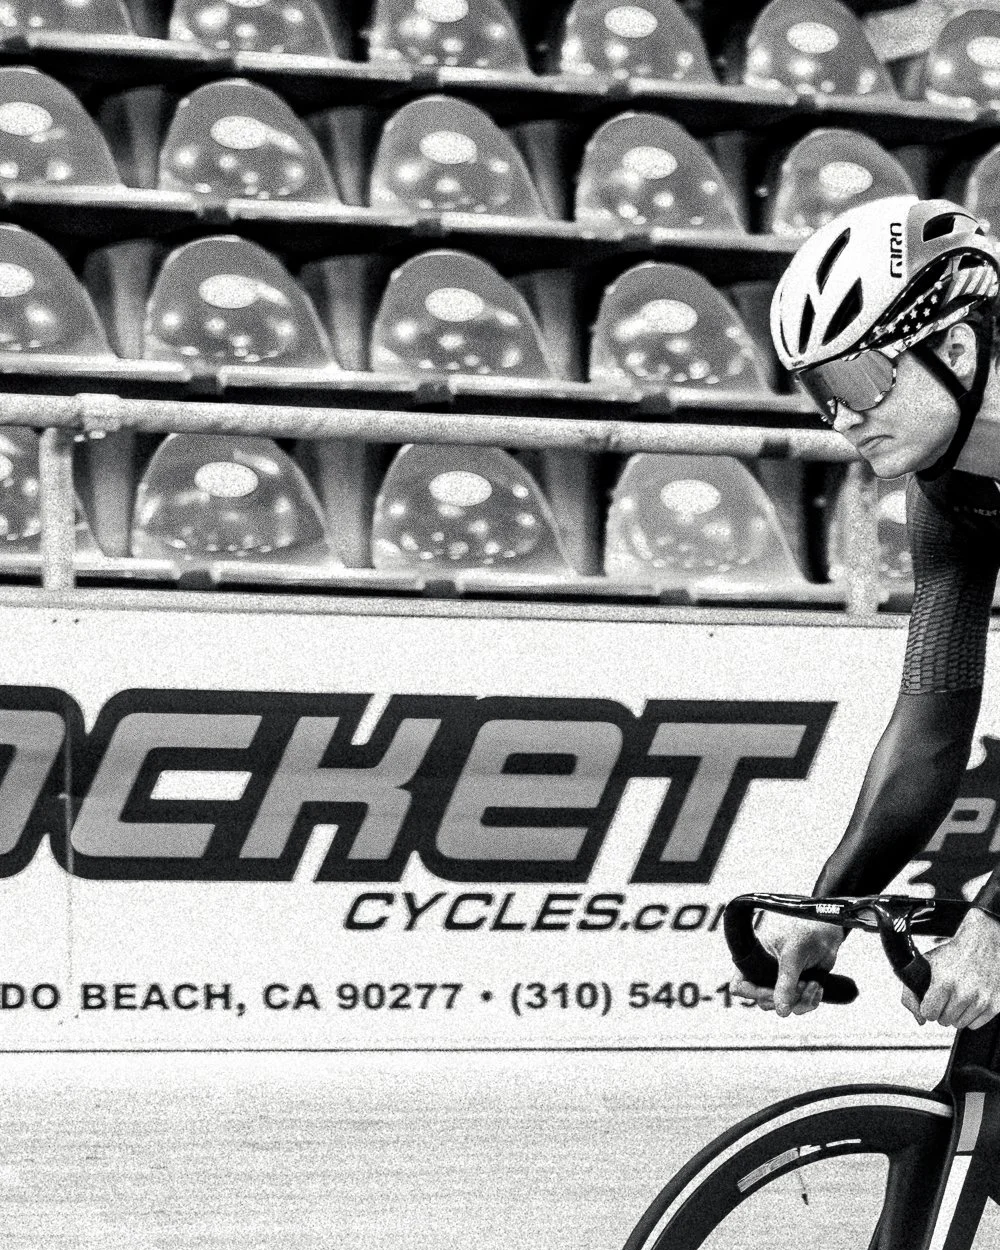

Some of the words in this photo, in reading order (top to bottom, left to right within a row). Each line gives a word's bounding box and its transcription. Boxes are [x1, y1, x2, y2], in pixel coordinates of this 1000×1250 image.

[889, 222, 903, 279] GIRO
[80, 982, 247, 1017] BEACH,
[262, 982, 321, 1011] CA
[336, 982, 465, 1010] 90277
[510, 981, 613, 1017] (310)
